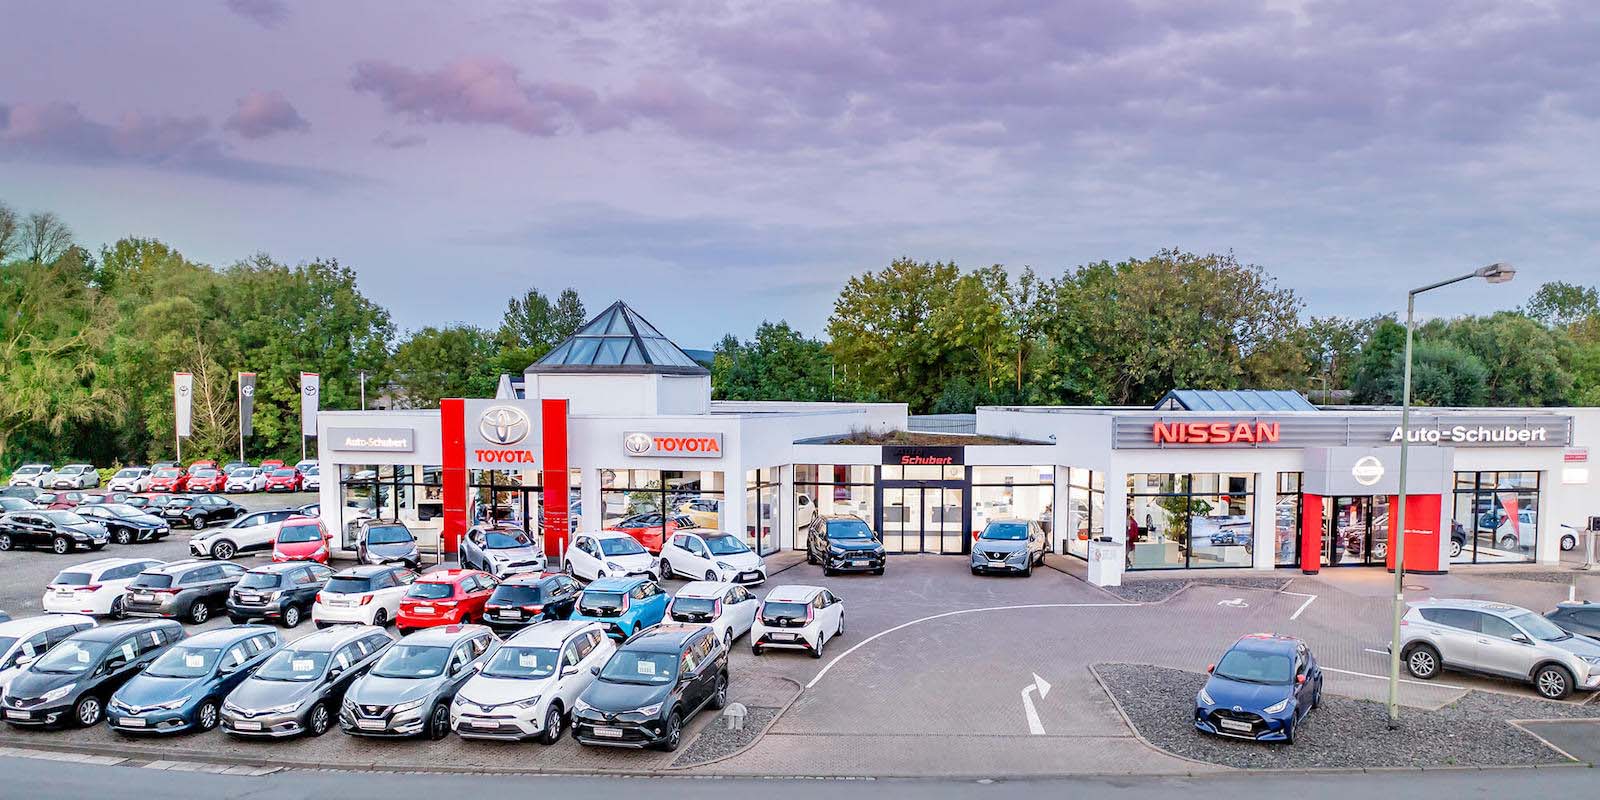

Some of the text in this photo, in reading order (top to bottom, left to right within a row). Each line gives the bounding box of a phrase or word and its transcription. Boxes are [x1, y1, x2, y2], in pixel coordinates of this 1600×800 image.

[1153, 421, 1280, 443] NISSAN
[1390, 425, 1547, 442] Auto-Schubert
[345, 437, 408, 448] Auto-Schubert
[653, 437, 720, 452] TOYOTA
[475, 450, 536, 463] TOYOTA
[900, 455, 953, 465] Schubert
